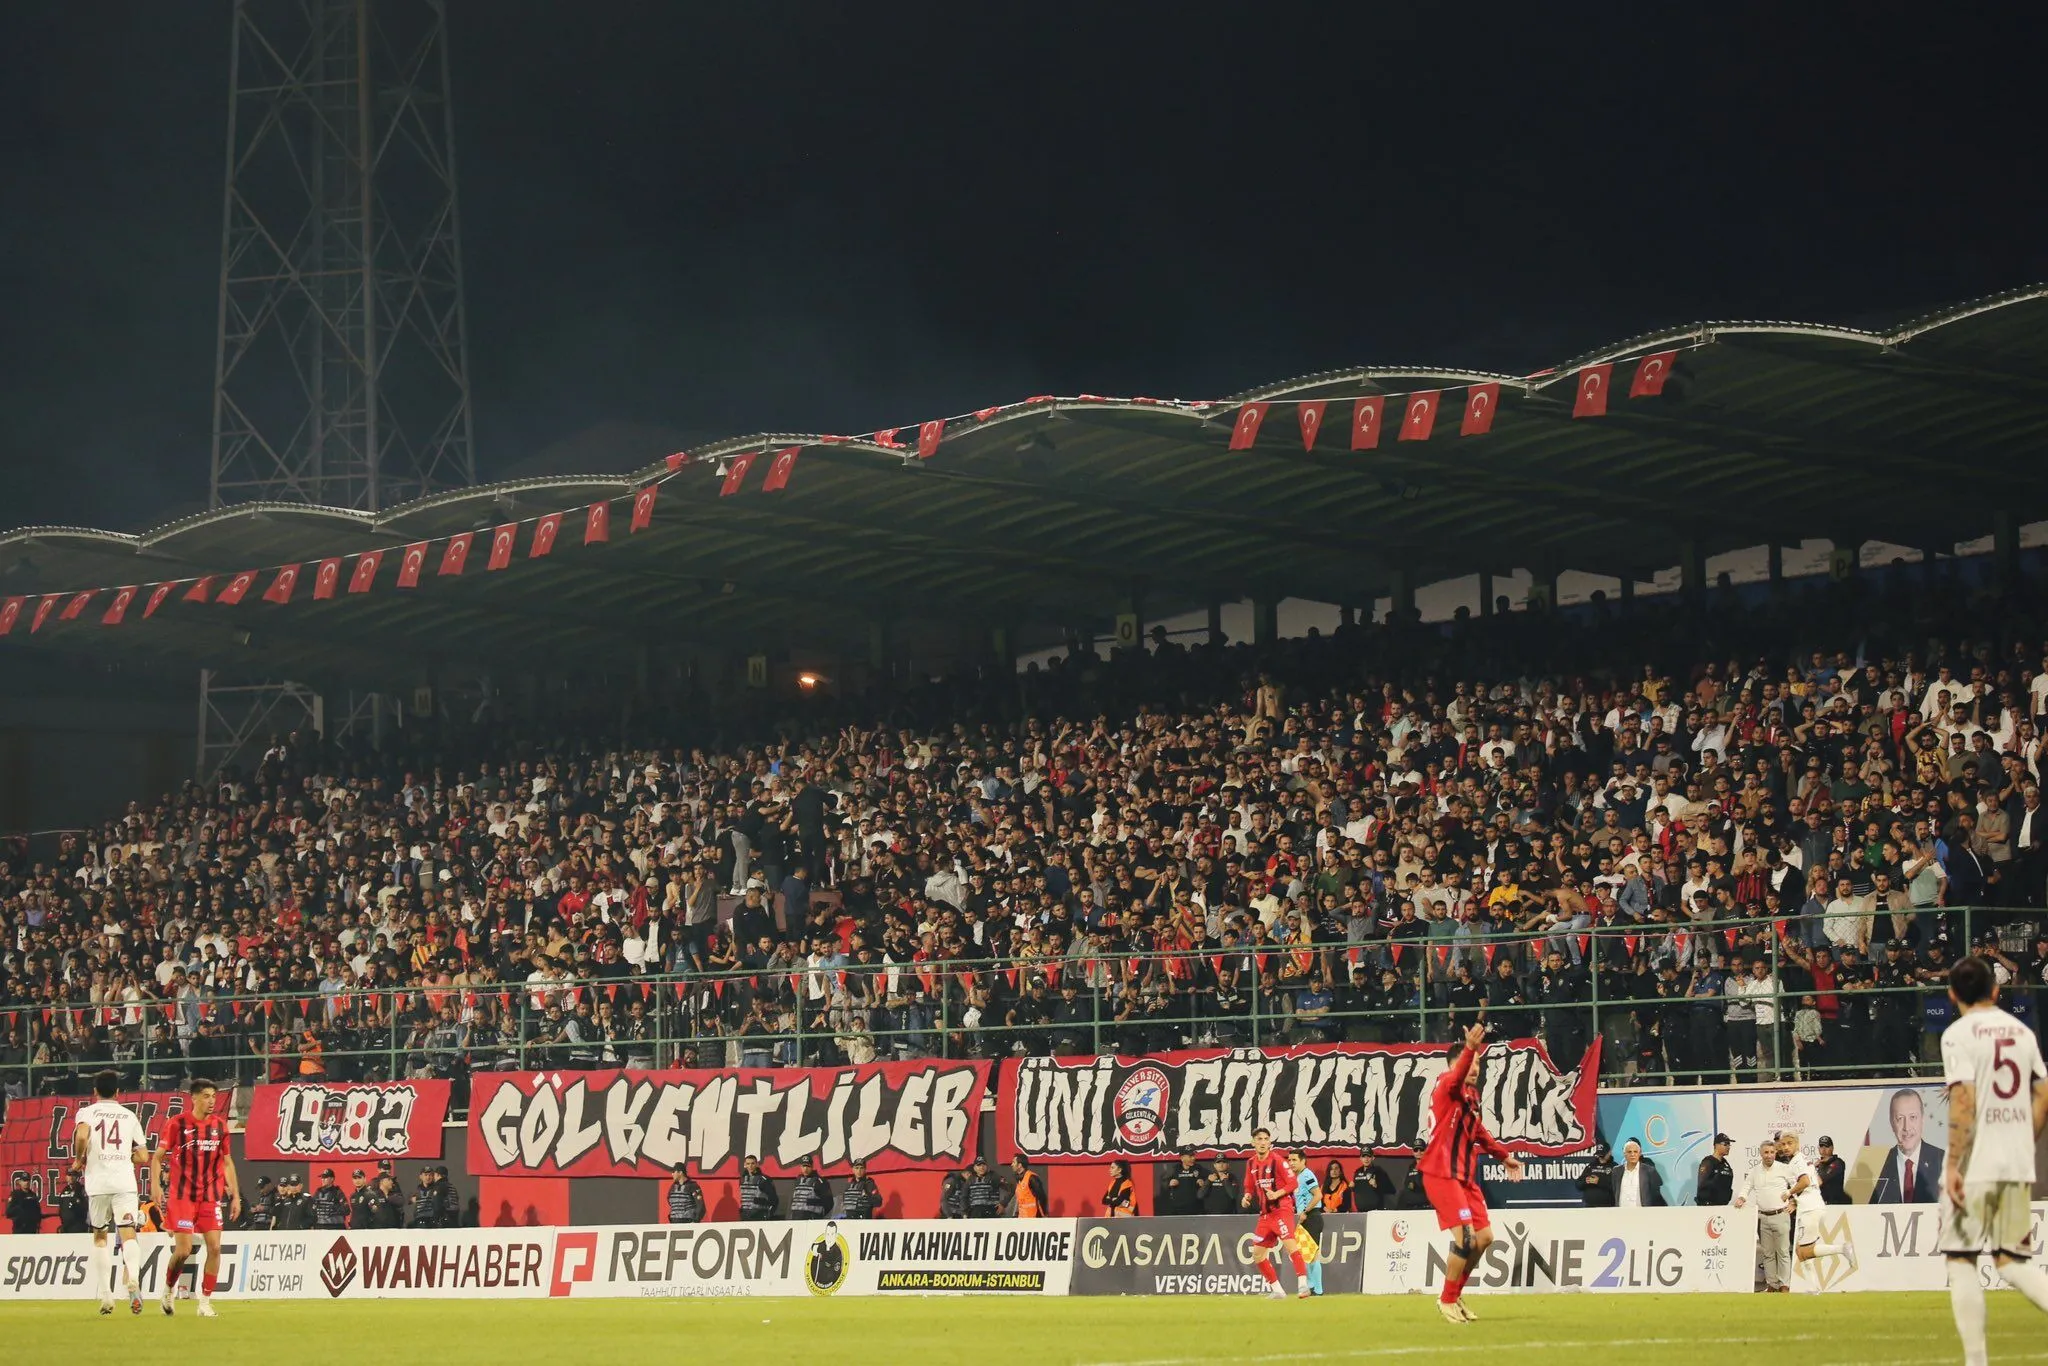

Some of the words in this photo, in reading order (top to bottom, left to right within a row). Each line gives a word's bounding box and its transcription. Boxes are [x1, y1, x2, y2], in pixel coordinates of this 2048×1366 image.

[2012, 1004, 2025, 1014] OLİS
[1992, 1038, 2021, 1099] 5
[274, 1085, 417, 1155] 1982
[479, 1069, 977, 1171] GÖLKENTLİLER
[1018, 1056, 1113, 1151] ÜNİ
[1985, 1108, 2027, 1124] ERCAN
[94, 1118, 122, 1150] 14
[362, 1243, 543, 1289] WANHABER
[608, 1227, 793, 1282] REFORM
[859, 1232, 896, 1261] VAN
[900, 1231, 990, 1261] KAHVALTI
[994, 1231, 1071, 1262] LOUNGE
[1082, 1225, 1224, 1269] CASABA
[1237, 1231, 1362, 1265] GRUP
[3, 1251, 89, 1292] sports
[250, 1270, 274, 1292] ÜST
[277, 1273, 303, 1292] YAPI
